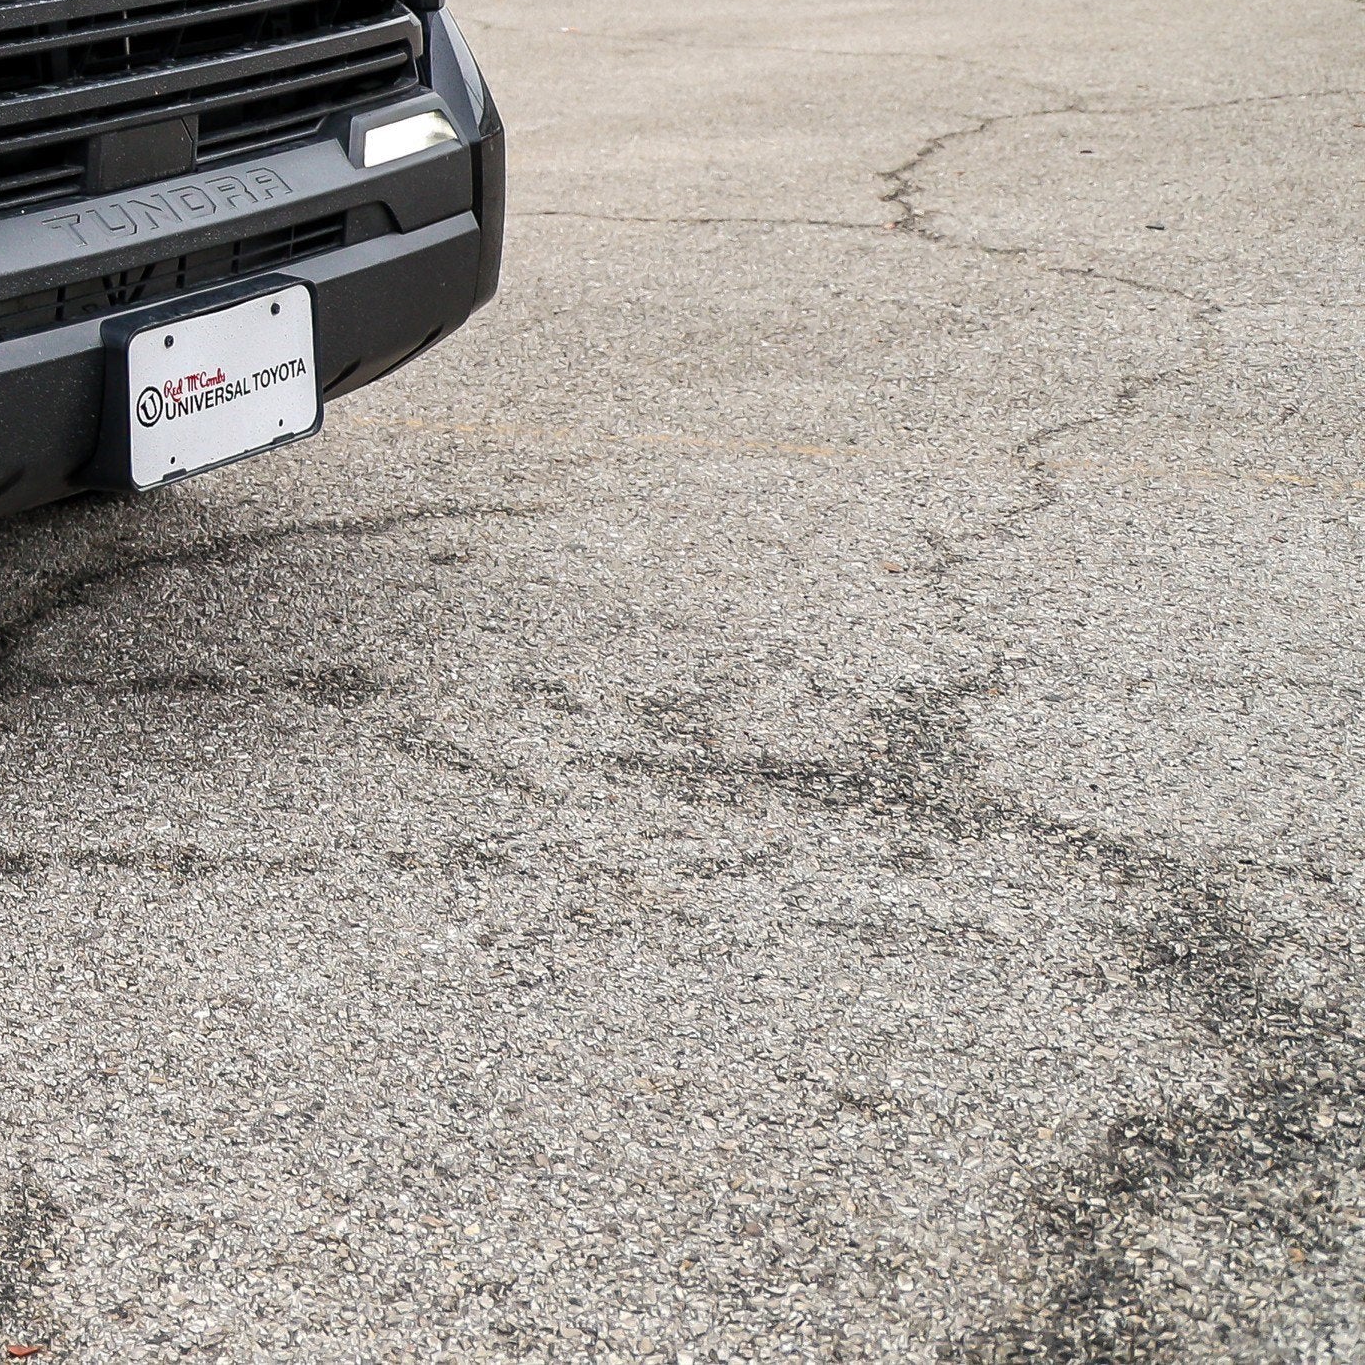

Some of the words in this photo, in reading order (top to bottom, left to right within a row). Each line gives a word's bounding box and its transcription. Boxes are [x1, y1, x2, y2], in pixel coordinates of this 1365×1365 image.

[41, 166, 294, 248] TUNDRA
[163, 378, 183, 402] Red
[165, 377, 251, 420] UNIVERSAL
[252, 357, 307, 392] TOYOTA
